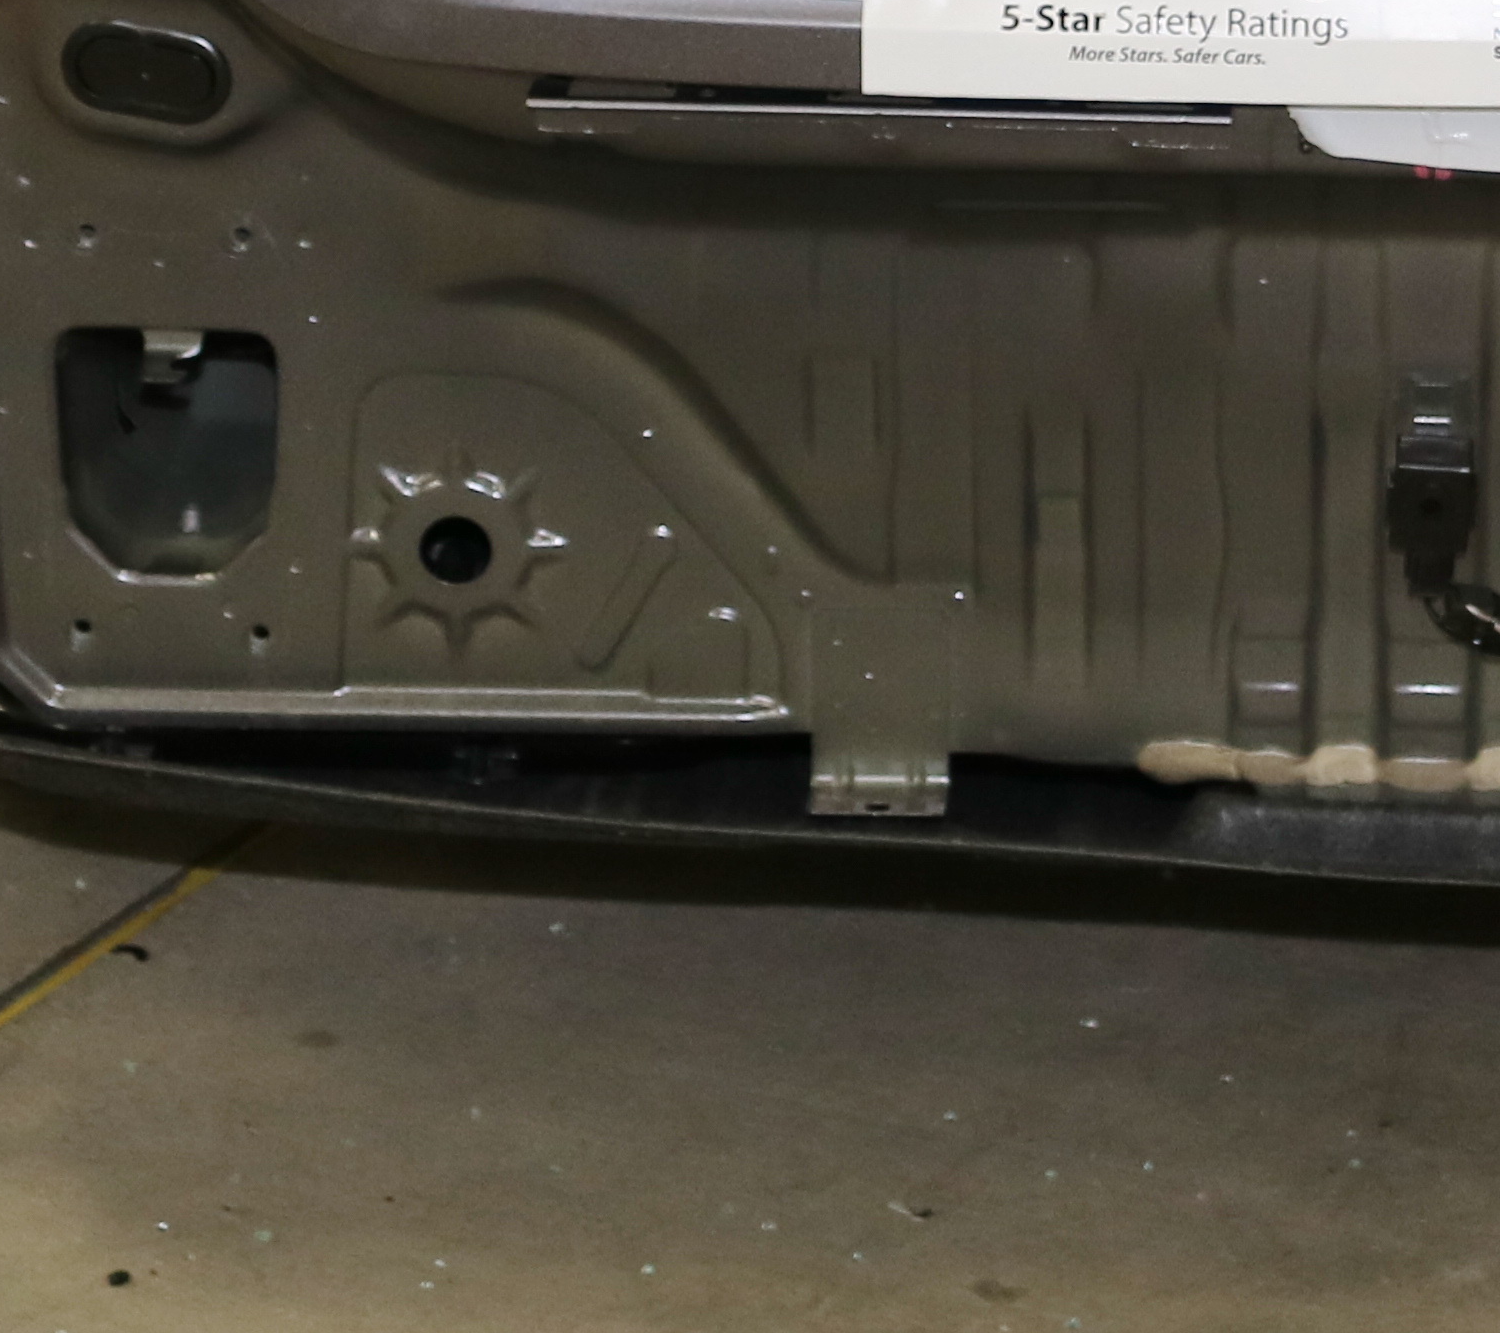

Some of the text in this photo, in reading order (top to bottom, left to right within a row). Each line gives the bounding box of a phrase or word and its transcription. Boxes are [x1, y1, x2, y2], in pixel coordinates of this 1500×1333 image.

[1000, 3, 1349, 45] 5-Star Safety Ratings
[1068, 45, 1267, 65] More Stars. Safer Cars.
